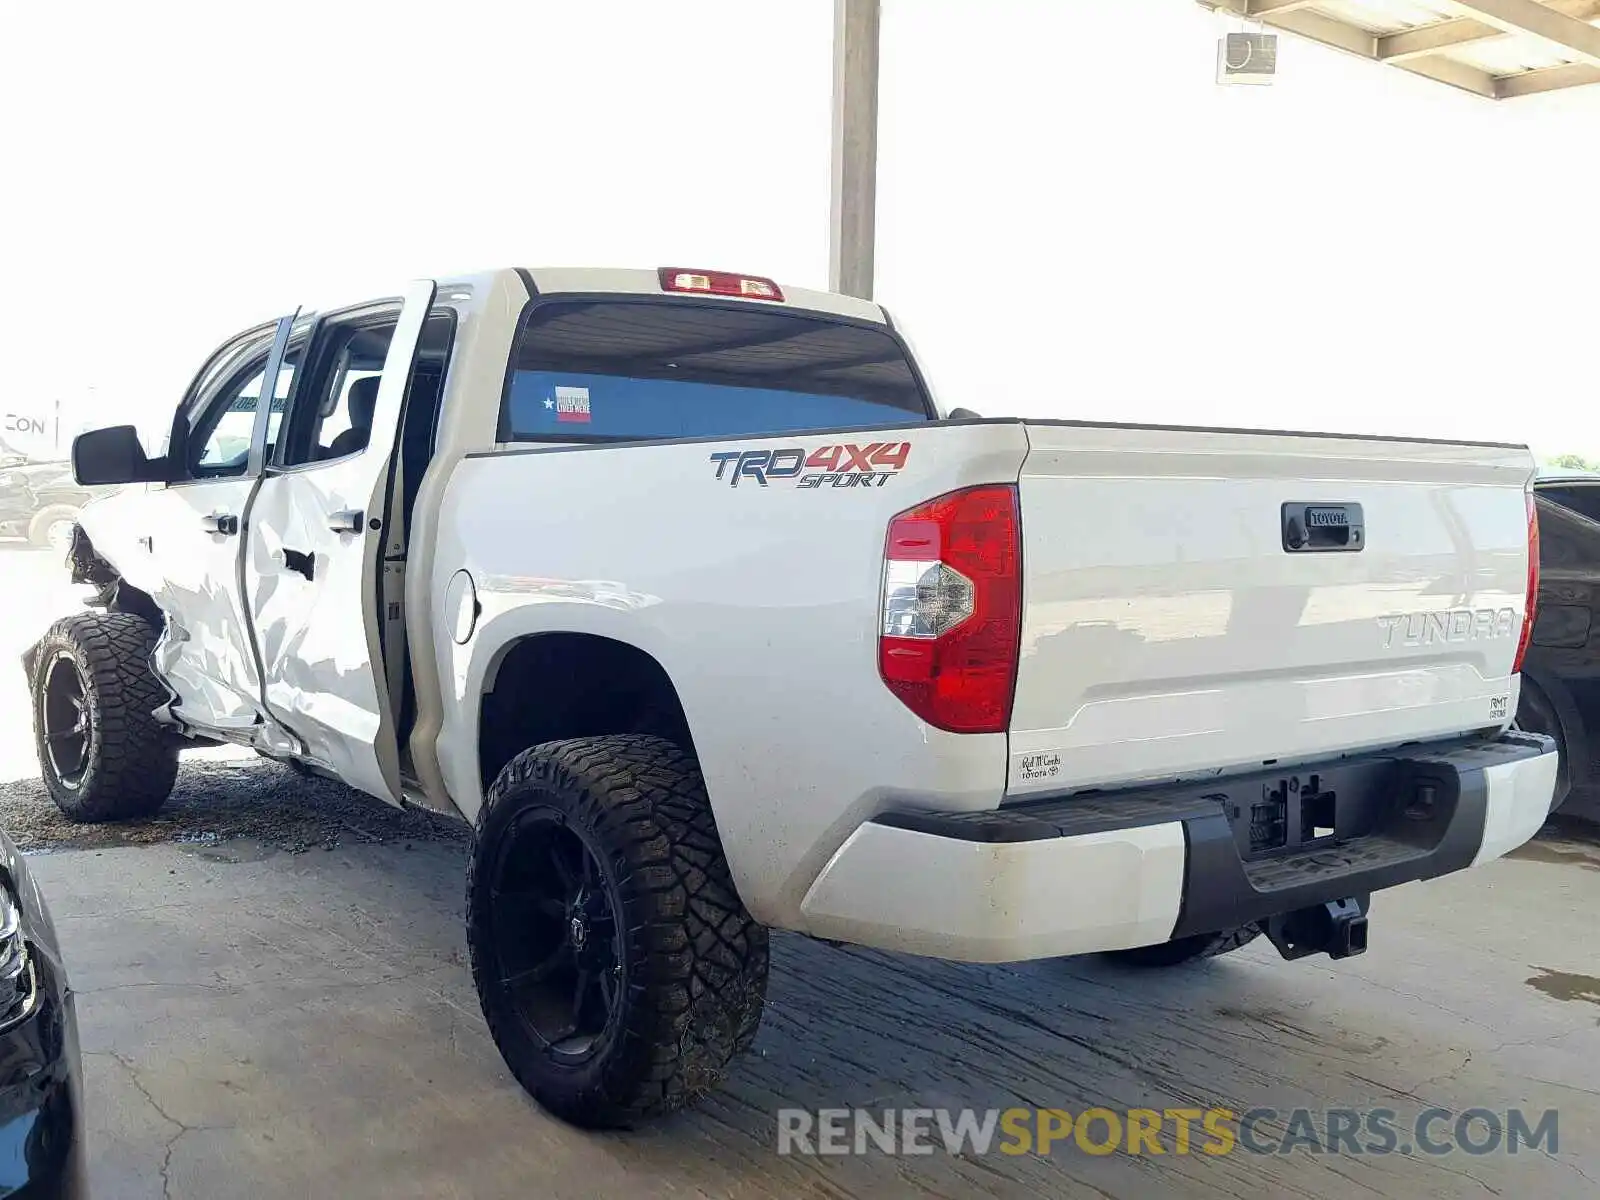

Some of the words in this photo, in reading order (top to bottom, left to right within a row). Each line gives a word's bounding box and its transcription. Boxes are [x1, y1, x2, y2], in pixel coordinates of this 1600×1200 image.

[710, 447, 806, 488] TRD
[796, 471, 898, 488] SPORT
[1378, 607, 1516, 648] TUNDRA
[1022, 770, 1047, 779] TOYOTA
